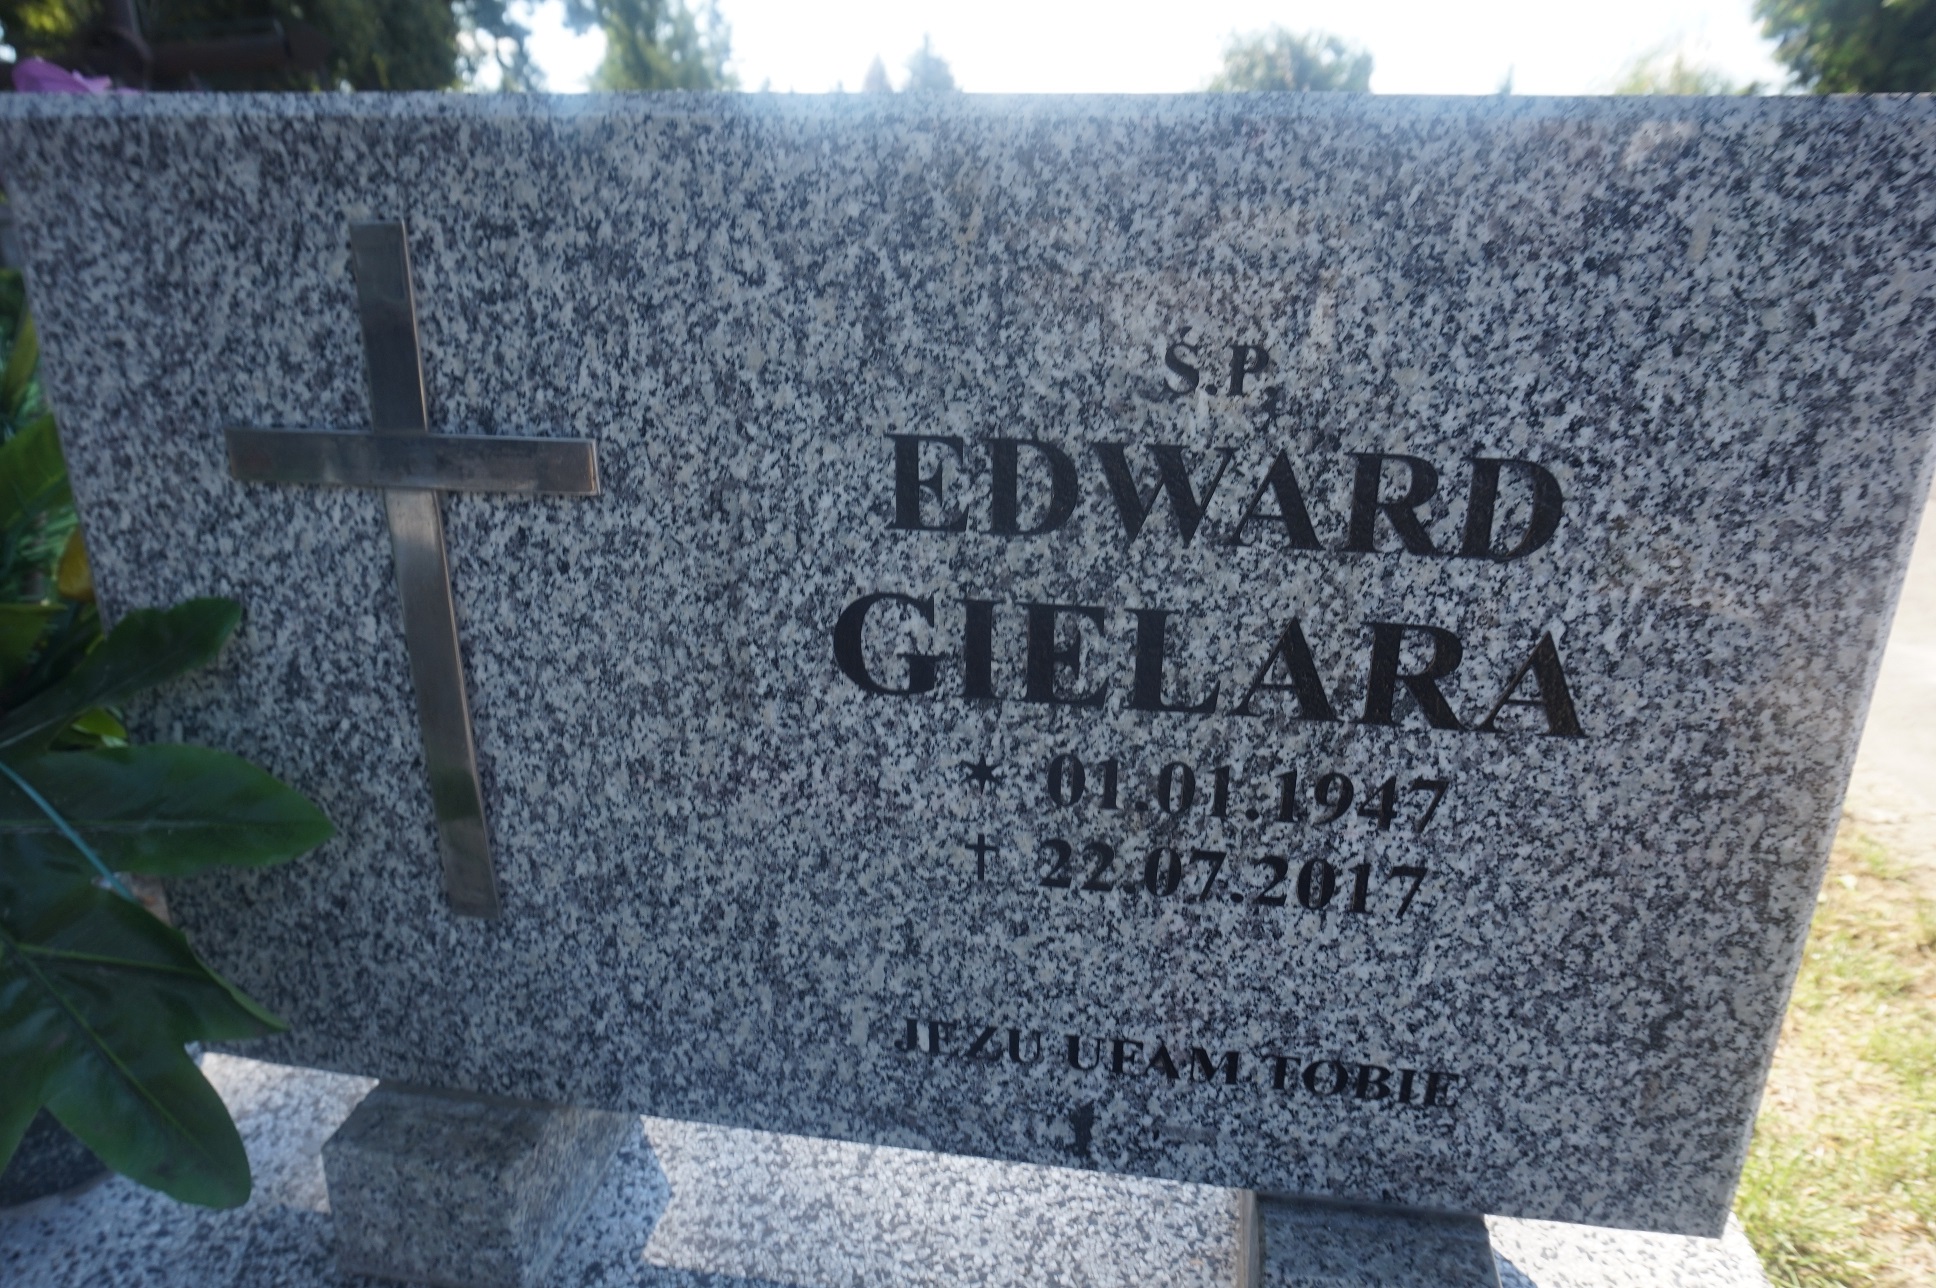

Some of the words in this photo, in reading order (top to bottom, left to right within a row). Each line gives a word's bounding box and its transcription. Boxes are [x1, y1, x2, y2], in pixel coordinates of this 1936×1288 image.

[886, 432, 1565, 561] EDWARD
[833, 592, 1588, 739] GIELARA
[1047, 753, 1450, 833] 01.01.1947
[1039, 838, 1430, 917] 22.07.2017
[895, 1017, 1042, 1064] JEZU
[1065, 1034, 1239, 1085] UFAM
[1261, 1053, 1461, 1108] TOBIE
